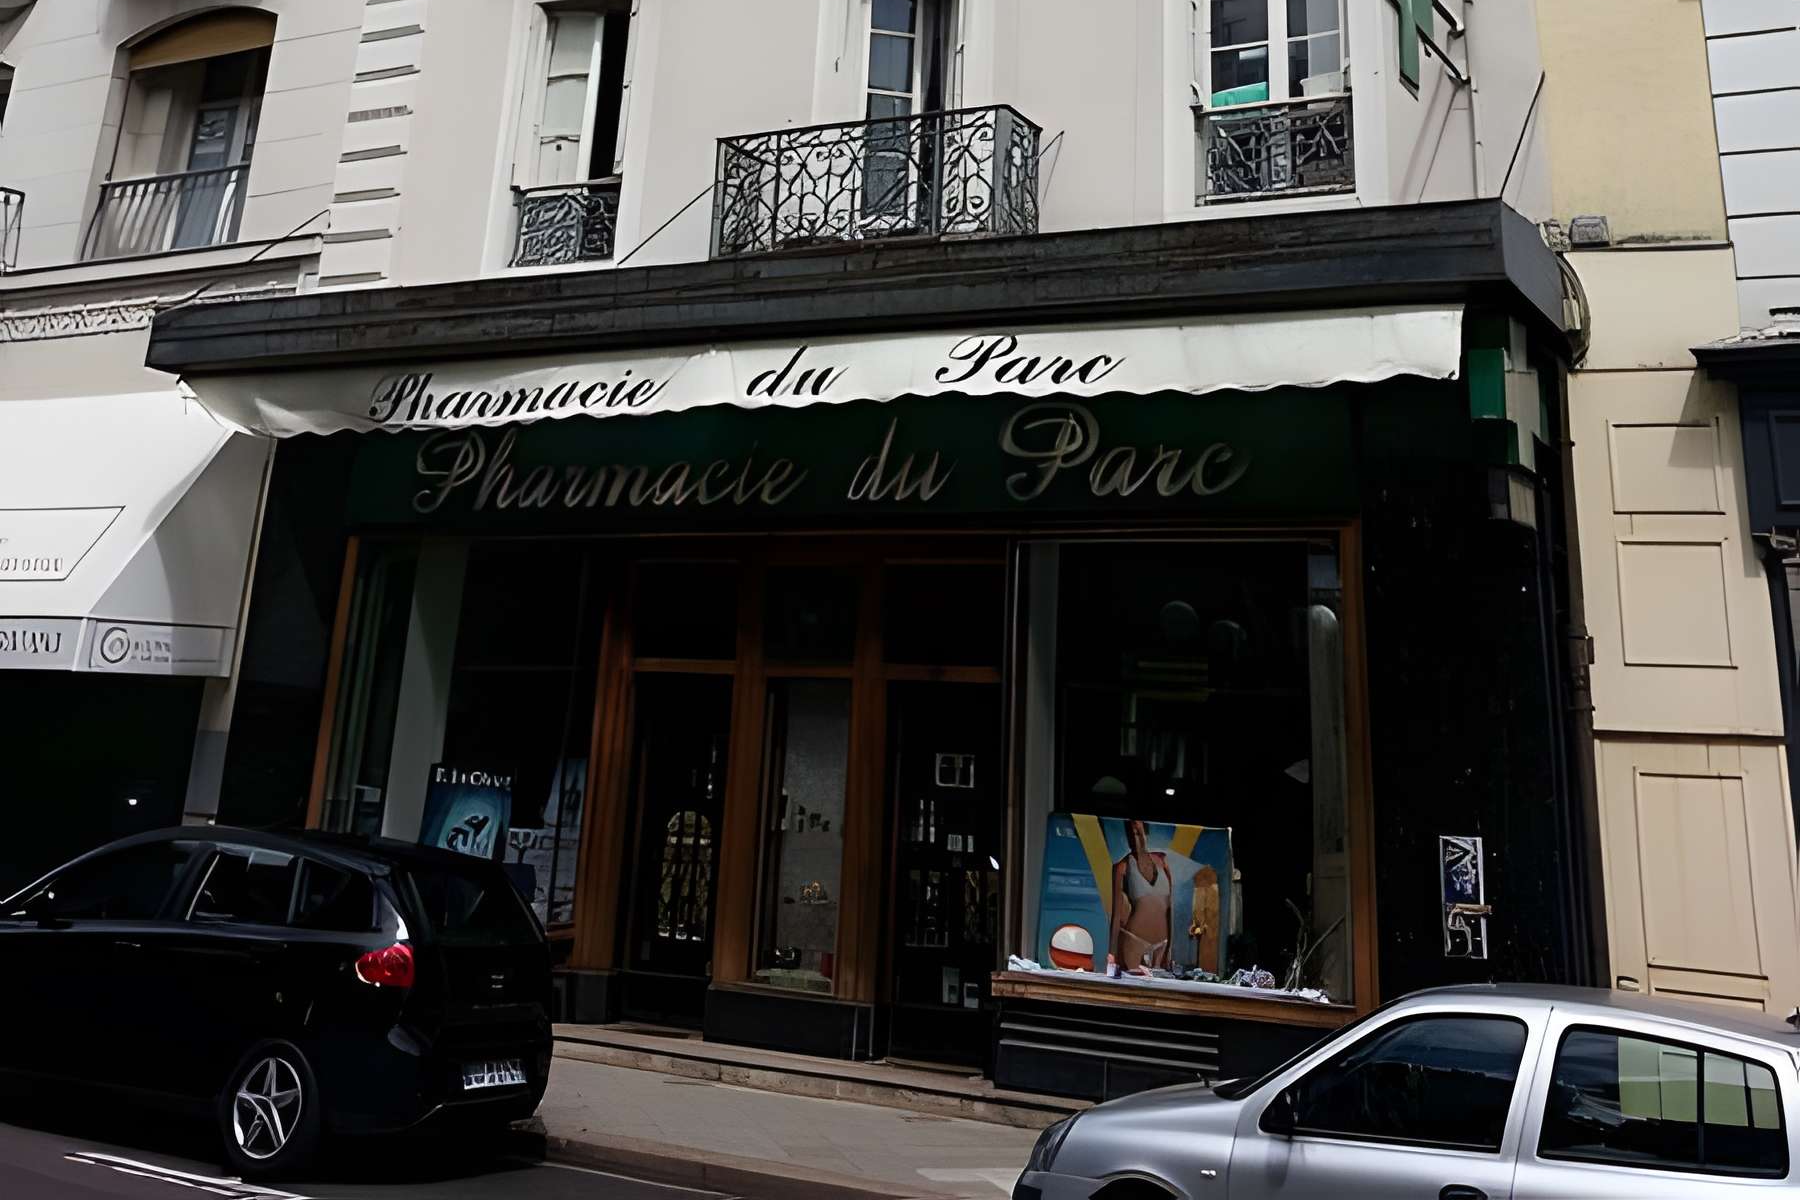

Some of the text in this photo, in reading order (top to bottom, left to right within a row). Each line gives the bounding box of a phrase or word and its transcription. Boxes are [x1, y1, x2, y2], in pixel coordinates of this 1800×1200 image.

[368, 334, 1127, 422] Pharmacie du Parc
[413, 402, 1252, 514] Pharmacie du Parc
